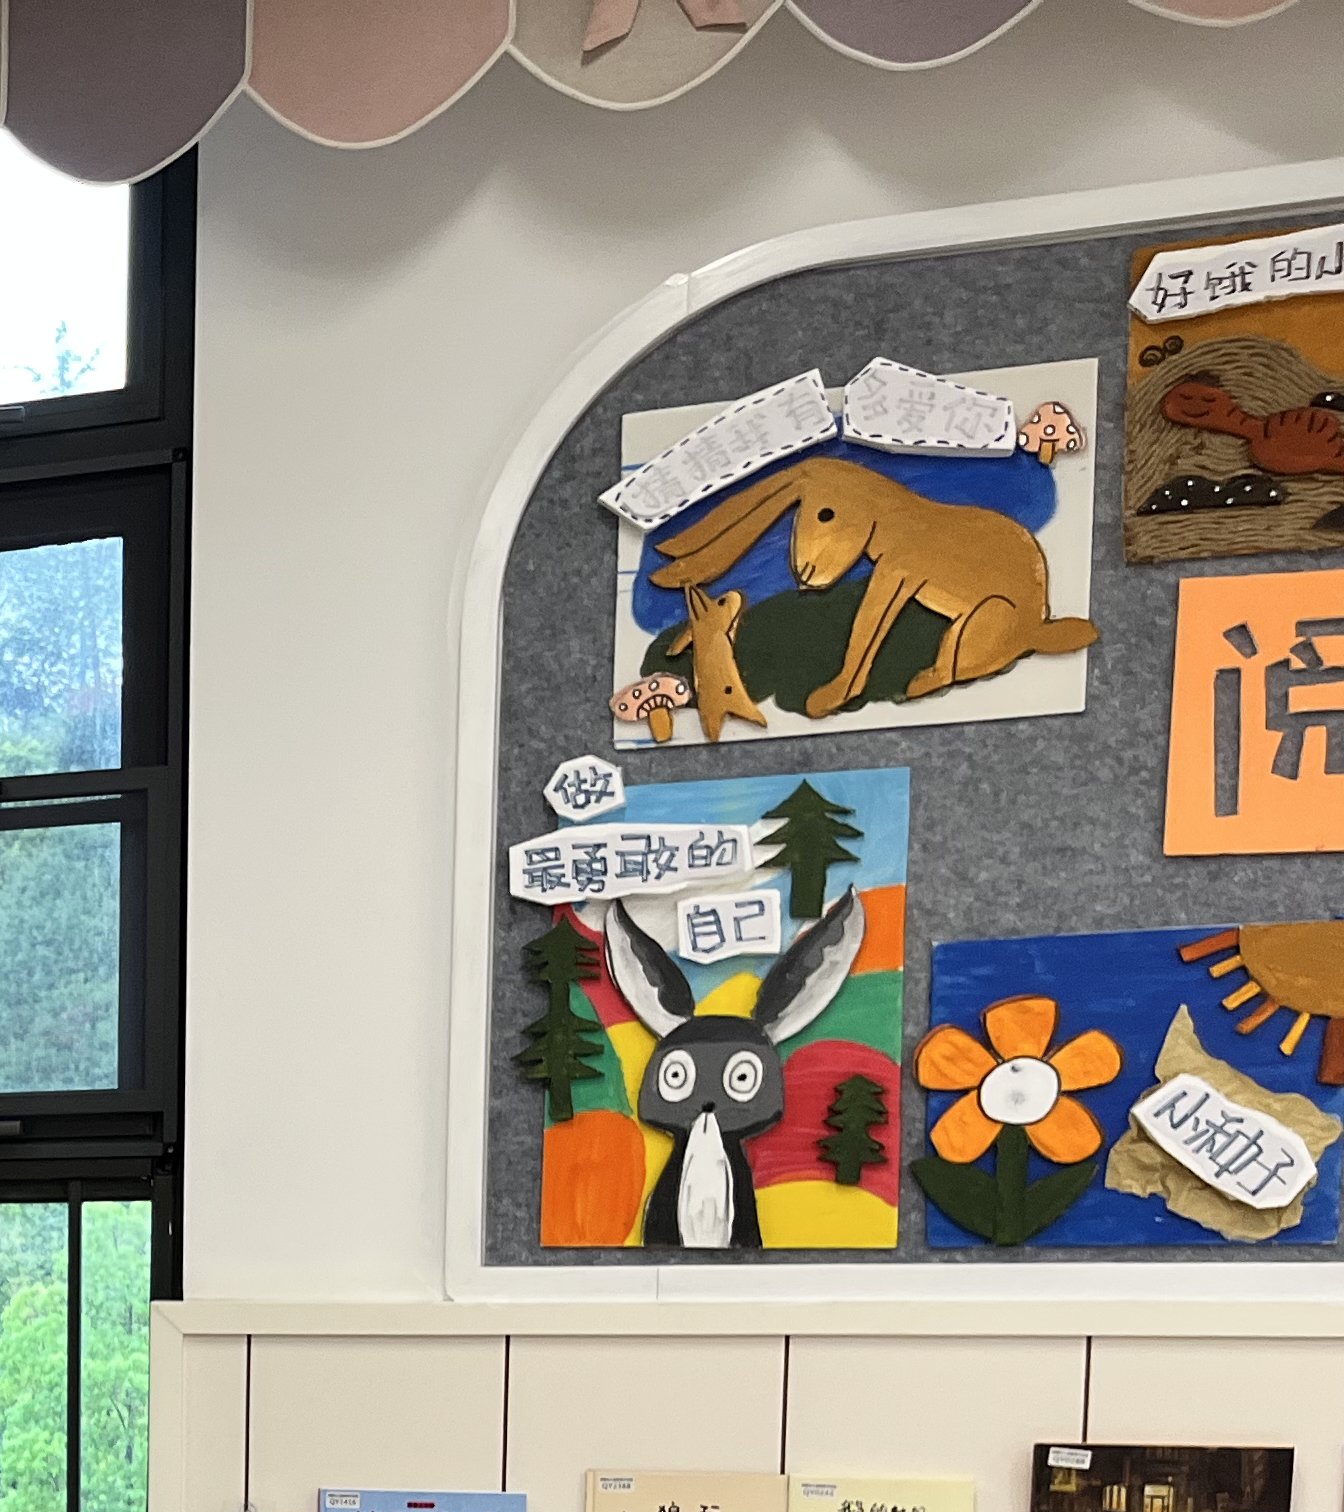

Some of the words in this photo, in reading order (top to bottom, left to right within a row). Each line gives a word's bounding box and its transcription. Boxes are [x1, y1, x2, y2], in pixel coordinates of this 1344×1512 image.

[630, 387, 825, 510] 猜猜我有
[553, 765, 616, 810] 做
[522, 830, 739, 893] 最勇敢的
[686, 900, 767, 954] 自己
[1153, 1089, 1295, 1197] 小种子
